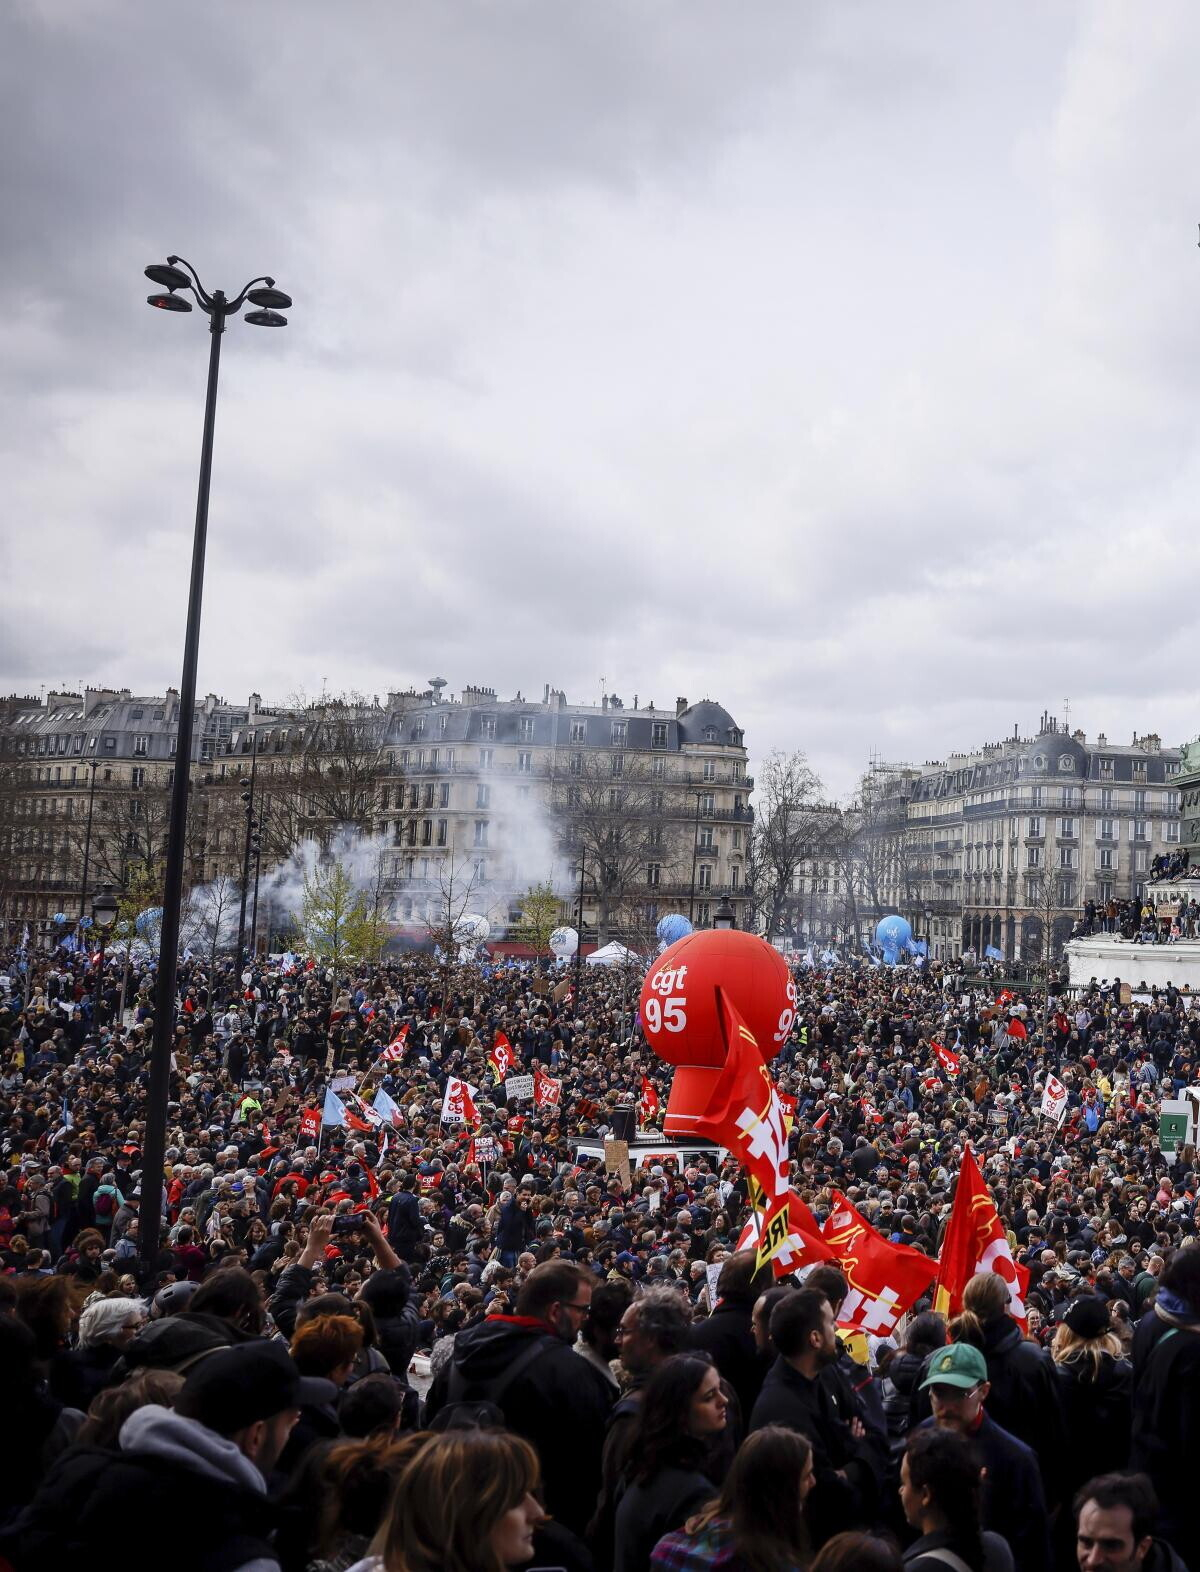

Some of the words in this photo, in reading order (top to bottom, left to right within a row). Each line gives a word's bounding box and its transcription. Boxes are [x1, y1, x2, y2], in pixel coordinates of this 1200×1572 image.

[651, 965, 688, 996] cgt
[645, 997, 687, 1034] 95
[475, 1137, 493, 1145] NOS
